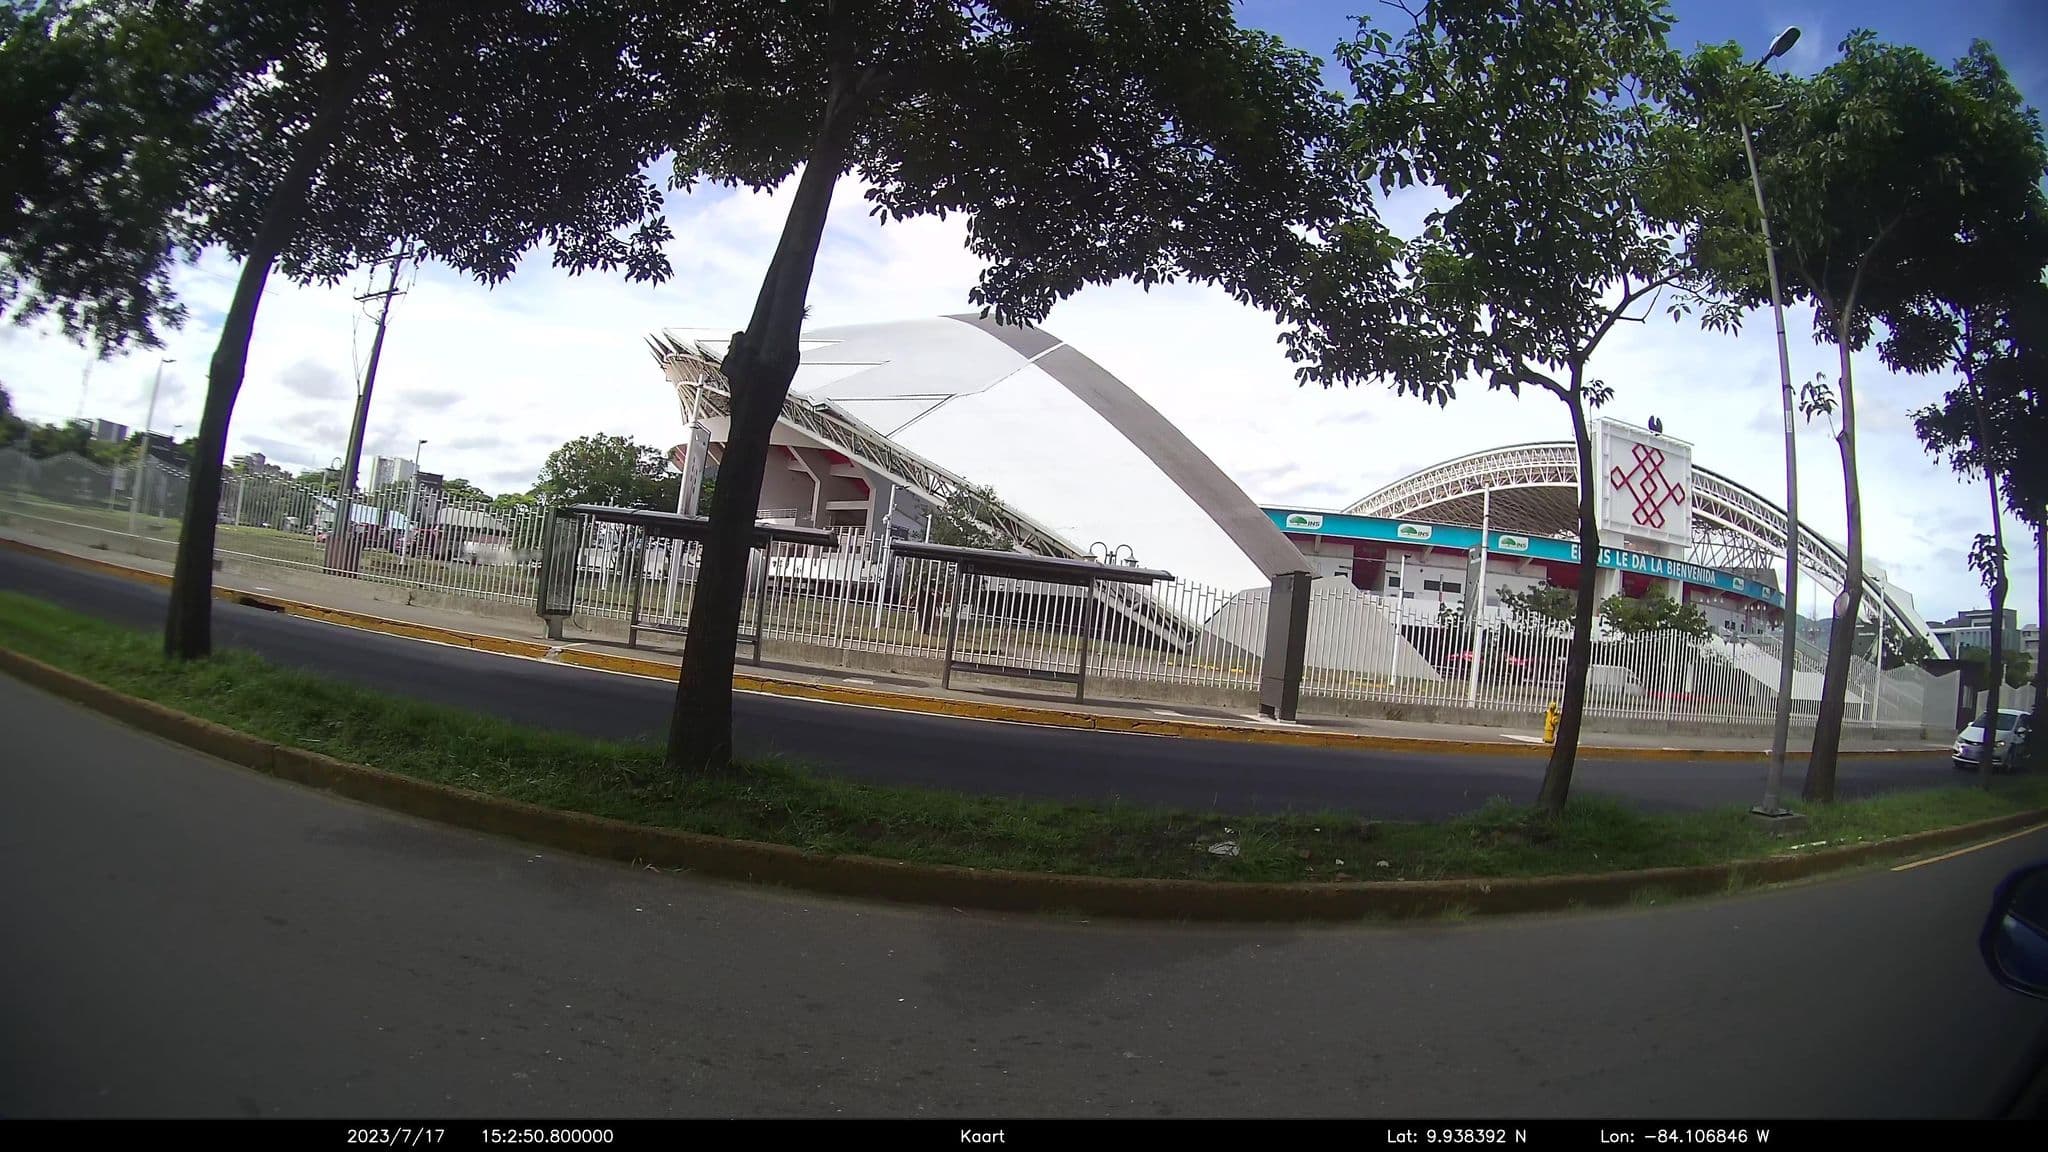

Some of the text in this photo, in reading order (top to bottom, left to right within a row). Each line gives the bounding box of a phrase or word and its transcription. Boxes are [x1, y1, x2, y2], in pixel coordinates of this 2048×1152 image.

[1616, 550, 1628, 568] LE
[1632, 553, 1647, 571] DA
[1651, 557, 1663, 574] LA
[1667, 560, 1716, 585] BIENVENIDA
